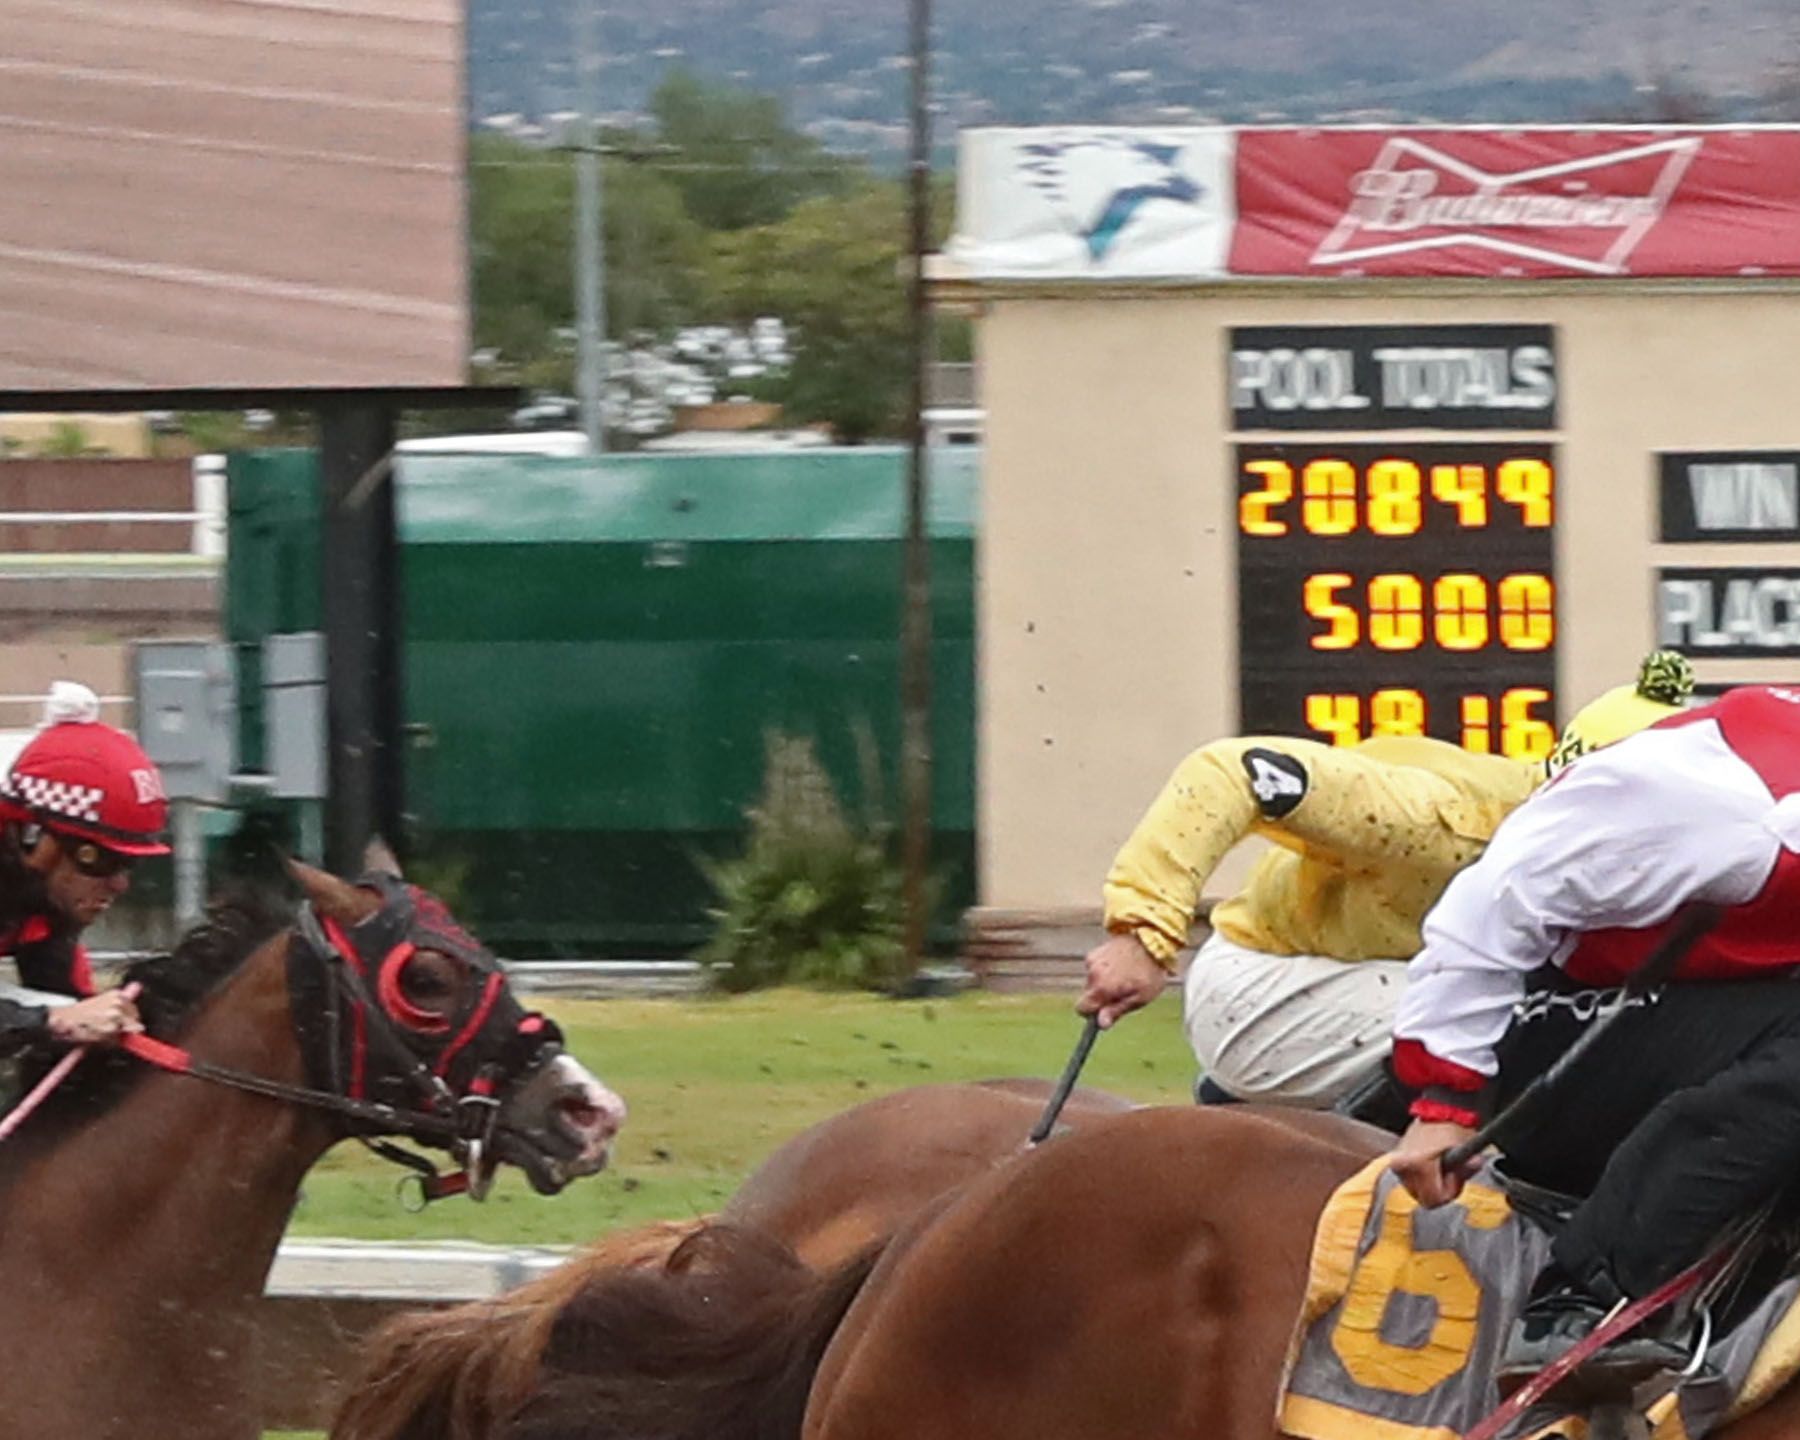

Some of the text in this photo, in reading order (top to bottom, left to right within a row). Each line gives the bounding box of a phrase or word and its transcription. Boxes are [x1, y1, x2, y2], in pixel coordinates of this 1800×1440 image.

[1230, 345, 1555, 409] POOL TOTALS
[1237, 457, 1557, 537] 20849
[1686, 462, 1799, 531] WIN
[1302, 572, 1558, 652] 5000
[1330, 1182, 1513, 1396] 6
